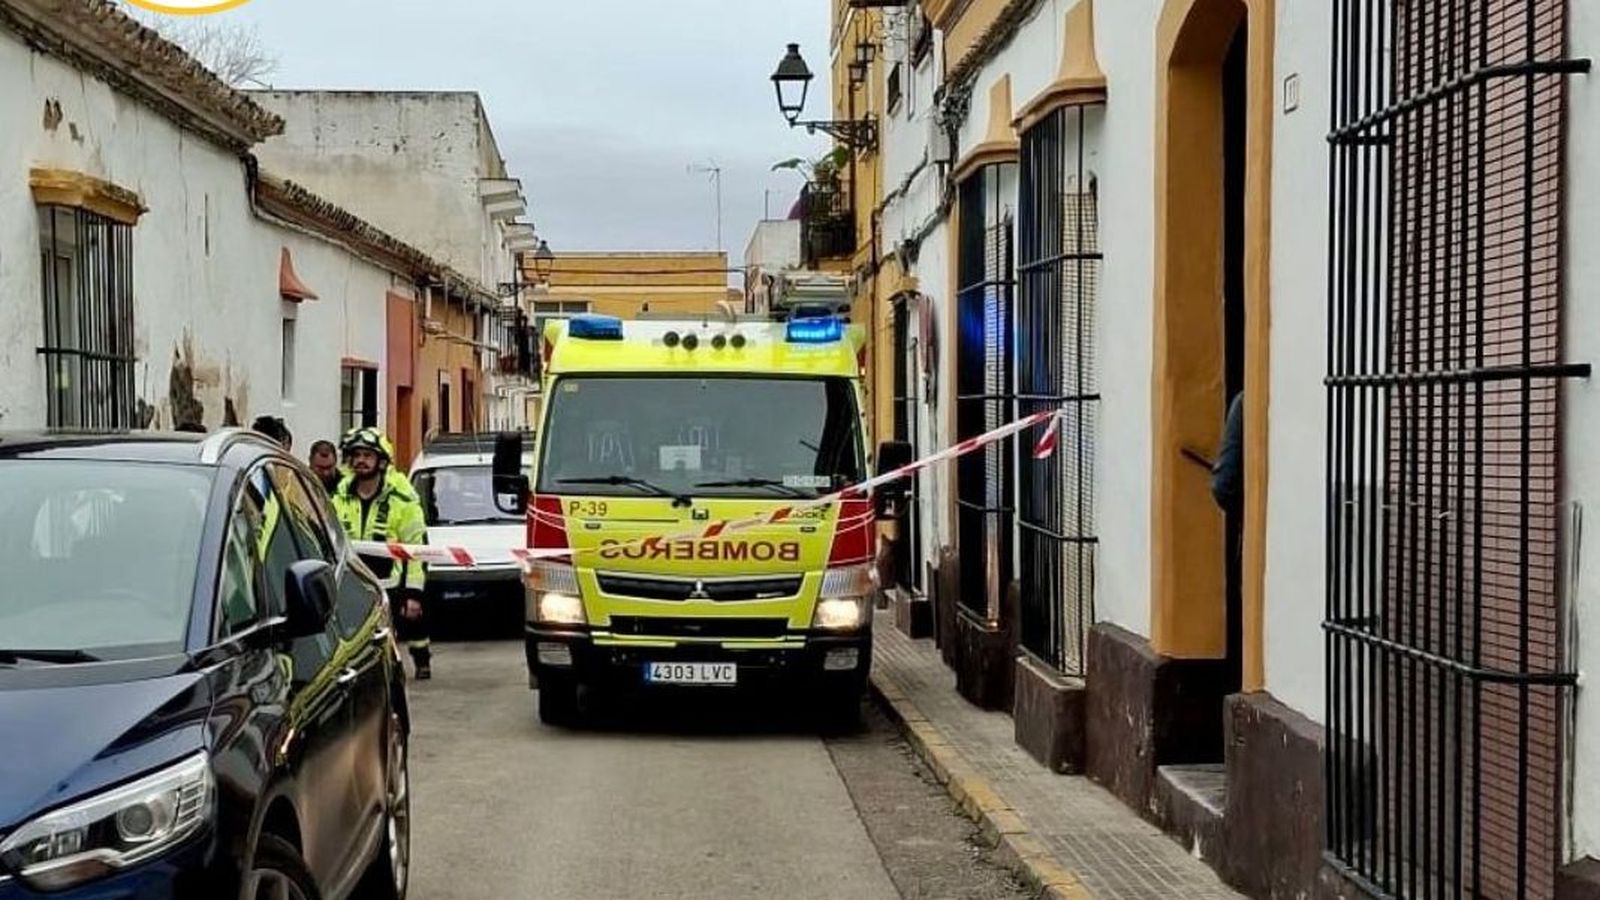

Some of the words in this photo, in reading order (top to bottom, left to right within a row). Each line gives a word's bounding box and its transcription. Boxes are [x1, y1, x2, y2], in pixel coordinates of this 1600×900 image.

[569, 500, 607, 516] P-39
[653, 665, 694, 680] 4303
[701, 665, 732, 681] LVC
